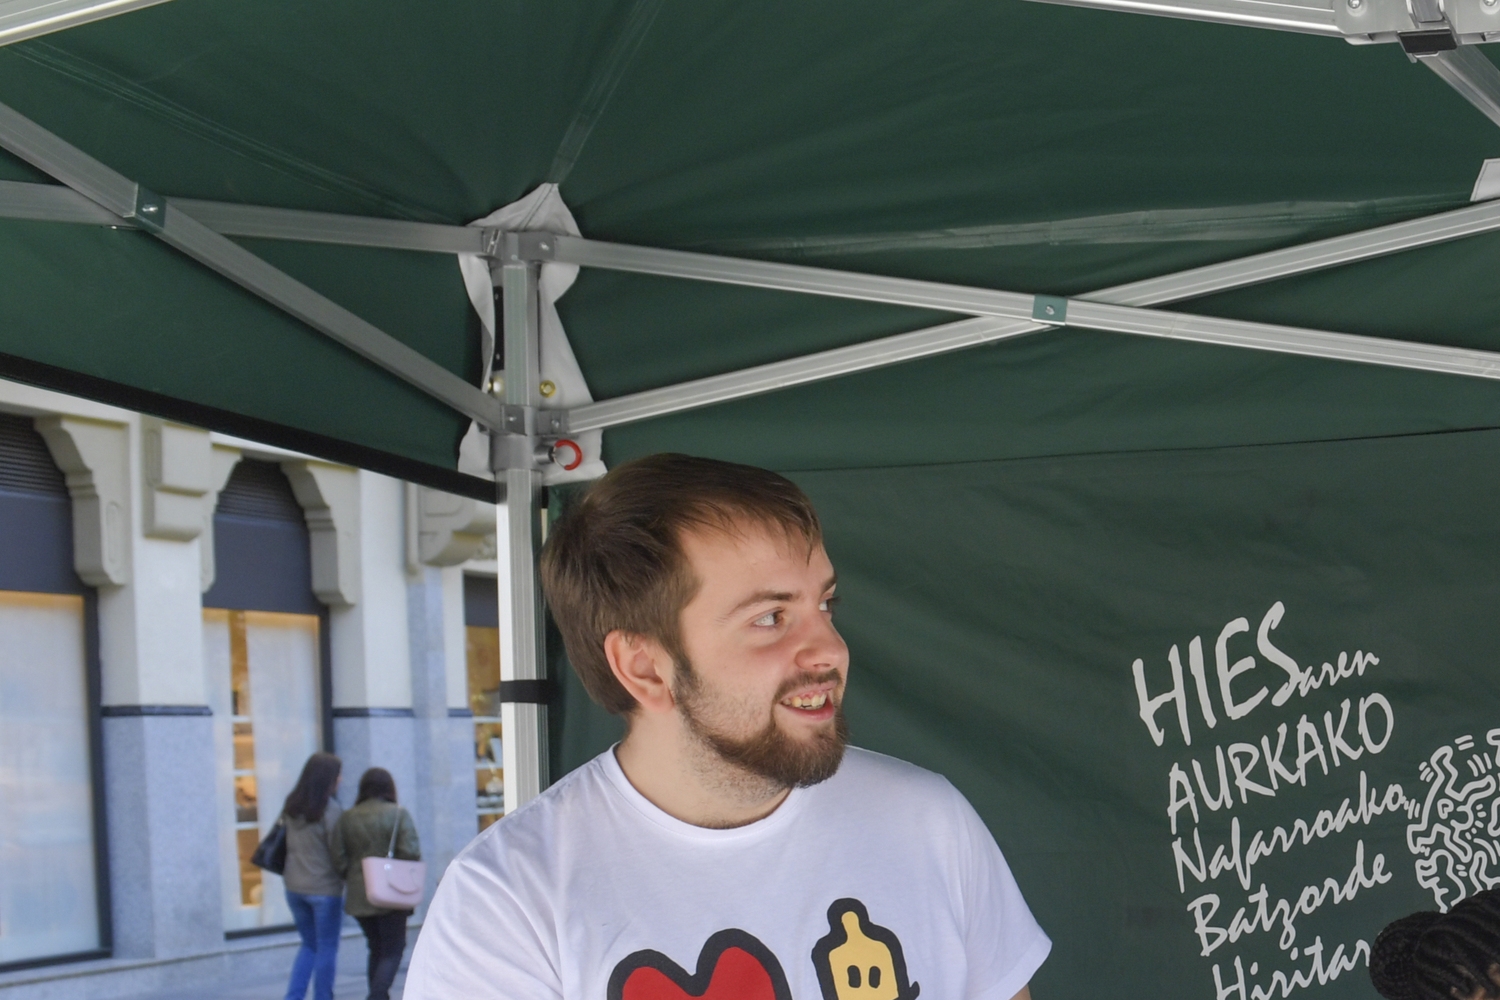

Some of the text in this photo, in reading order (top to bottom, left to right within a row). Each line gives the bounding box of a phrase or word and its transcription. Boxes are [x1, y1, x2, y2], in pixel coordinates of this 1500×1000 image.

[1166, 692, 1394, 833] AURKAKO
[1172, 771, 1406, 893] Nafarroako
[1187, 840, 1393, 956] Batzorde
